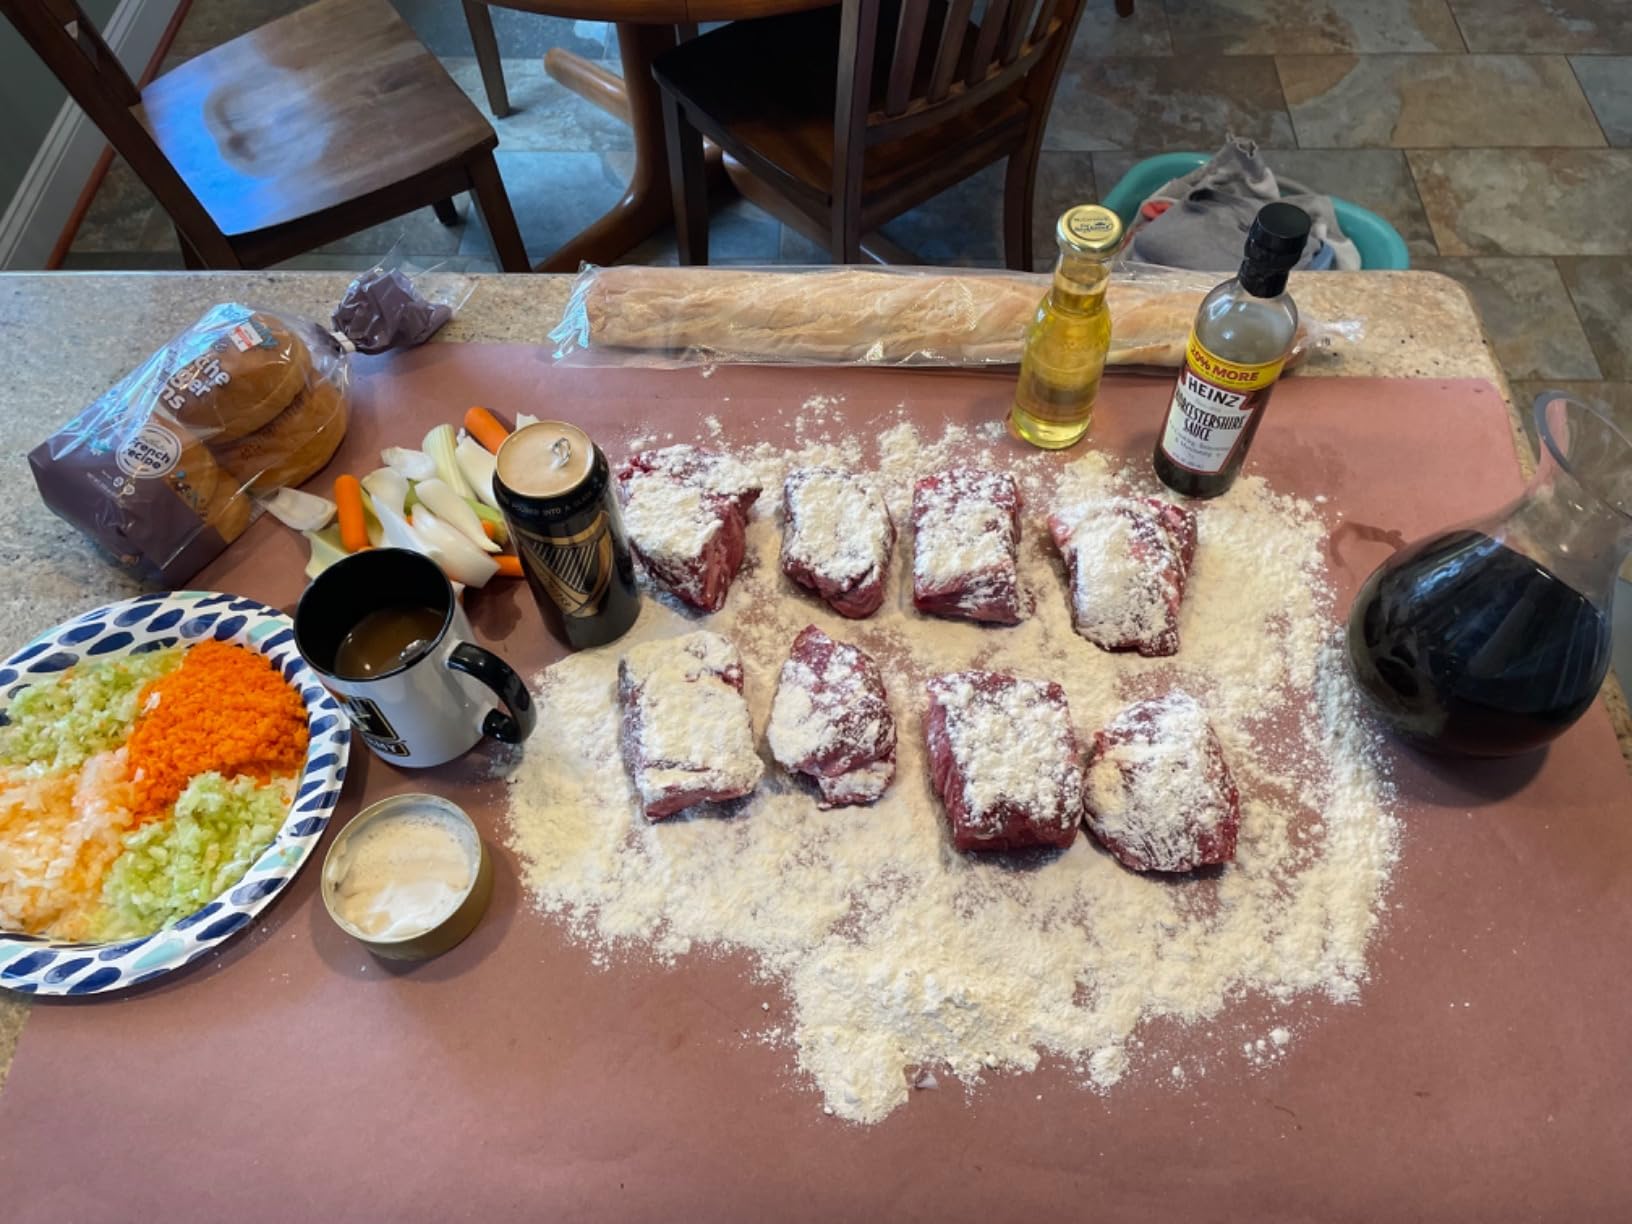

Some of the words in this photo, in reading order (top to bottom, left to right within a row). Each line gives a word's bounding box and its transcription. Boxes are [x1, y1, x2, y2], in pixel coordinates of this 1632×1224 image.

[1212, 364, 1260, 381] MORE
[1188, 377, 1241, 408] HEINZ
[1183, 418, 1213, 441] SAUCE
